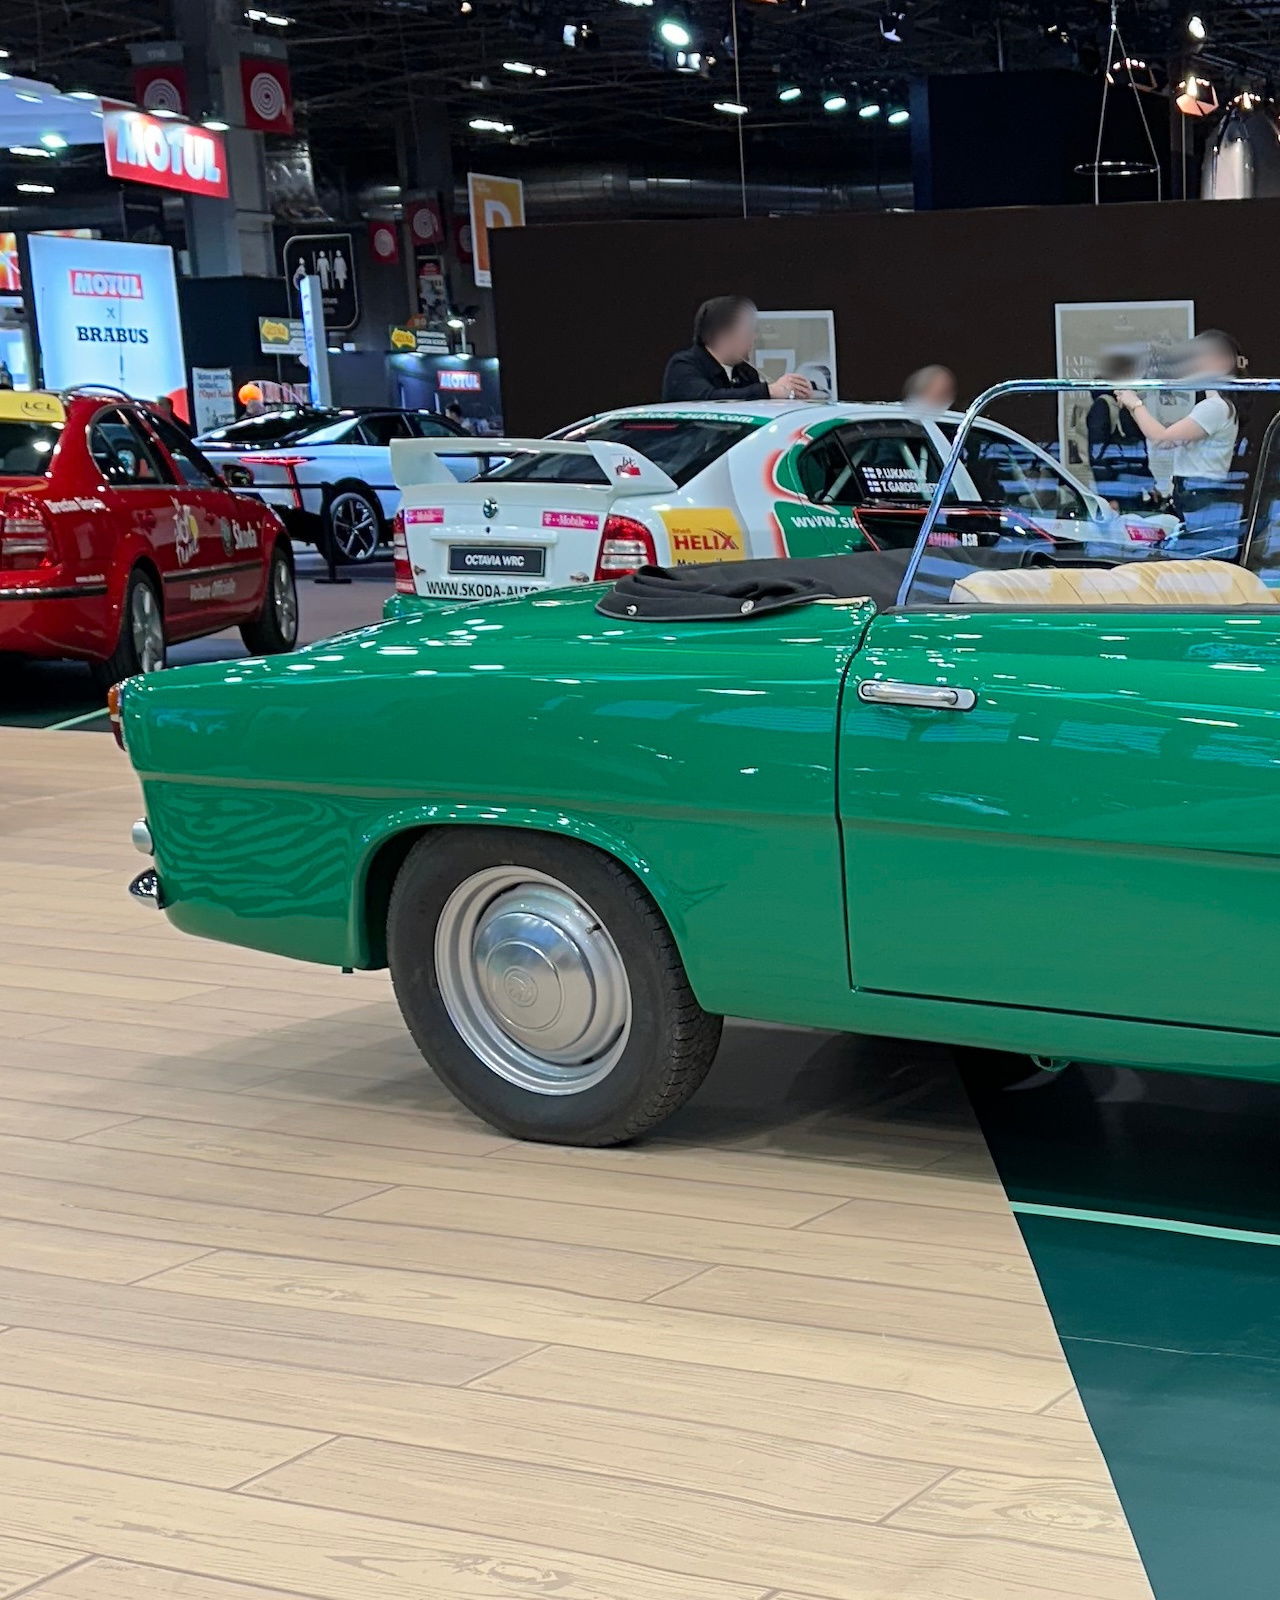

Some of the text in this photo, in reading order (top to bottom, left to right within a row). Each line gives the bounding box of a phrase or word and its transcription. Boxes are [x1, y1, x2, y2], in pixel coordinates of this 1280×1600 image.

[116, 118, 221, 184] MOTUL
[74, 272, 142, 297] MOTUL
[77, 326, 149, 344] BRABUS
[440, 373, 480, 388] MOTUL
[24, 402, 56, 411] LCL
[673, 534, 739, 550] HELIX
[464, 554, 525, 567] OCTAVIA WRC
